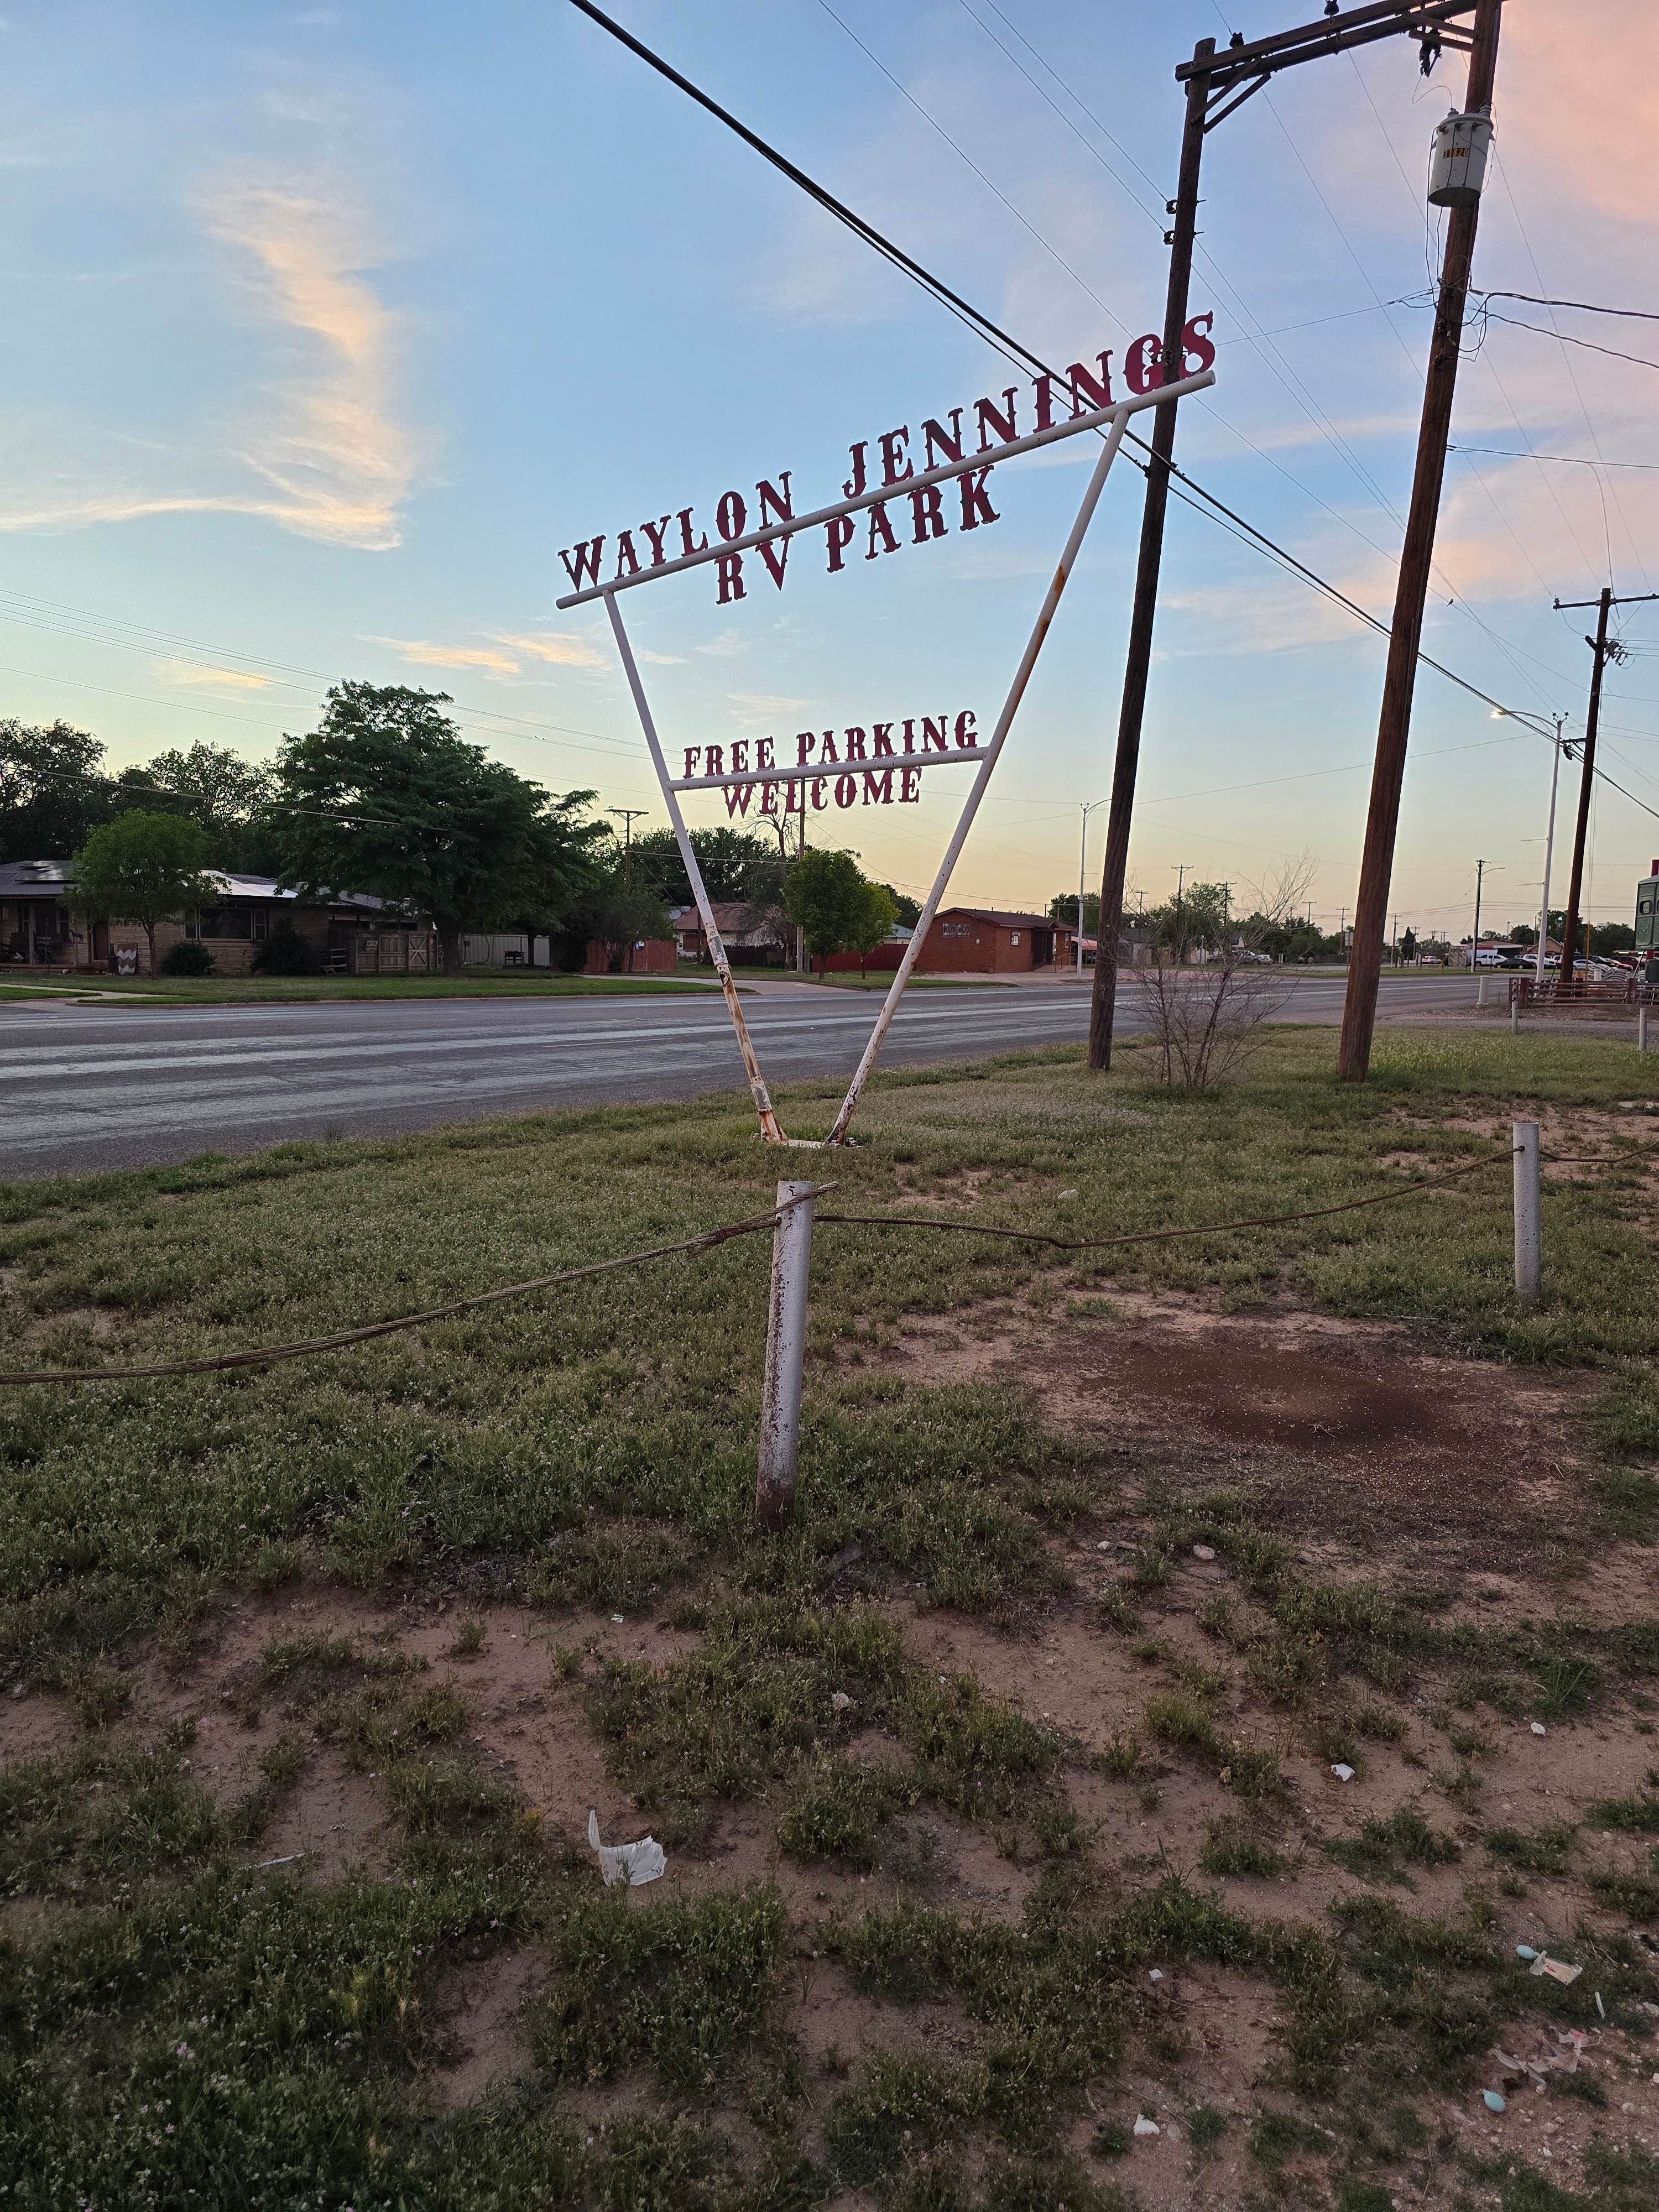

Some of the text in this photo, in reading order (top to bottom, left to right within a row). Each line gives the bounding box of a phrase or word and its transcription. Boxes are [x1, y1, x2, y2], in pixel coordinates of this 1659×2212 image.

[558, 310, 1216, 592] WAYLON JENNINGS
[714, 464, 1000, 604] RV PARK
[683, 710, 978, 779] FREE PARKING
[722, 765, 922, 819] WELCOME
